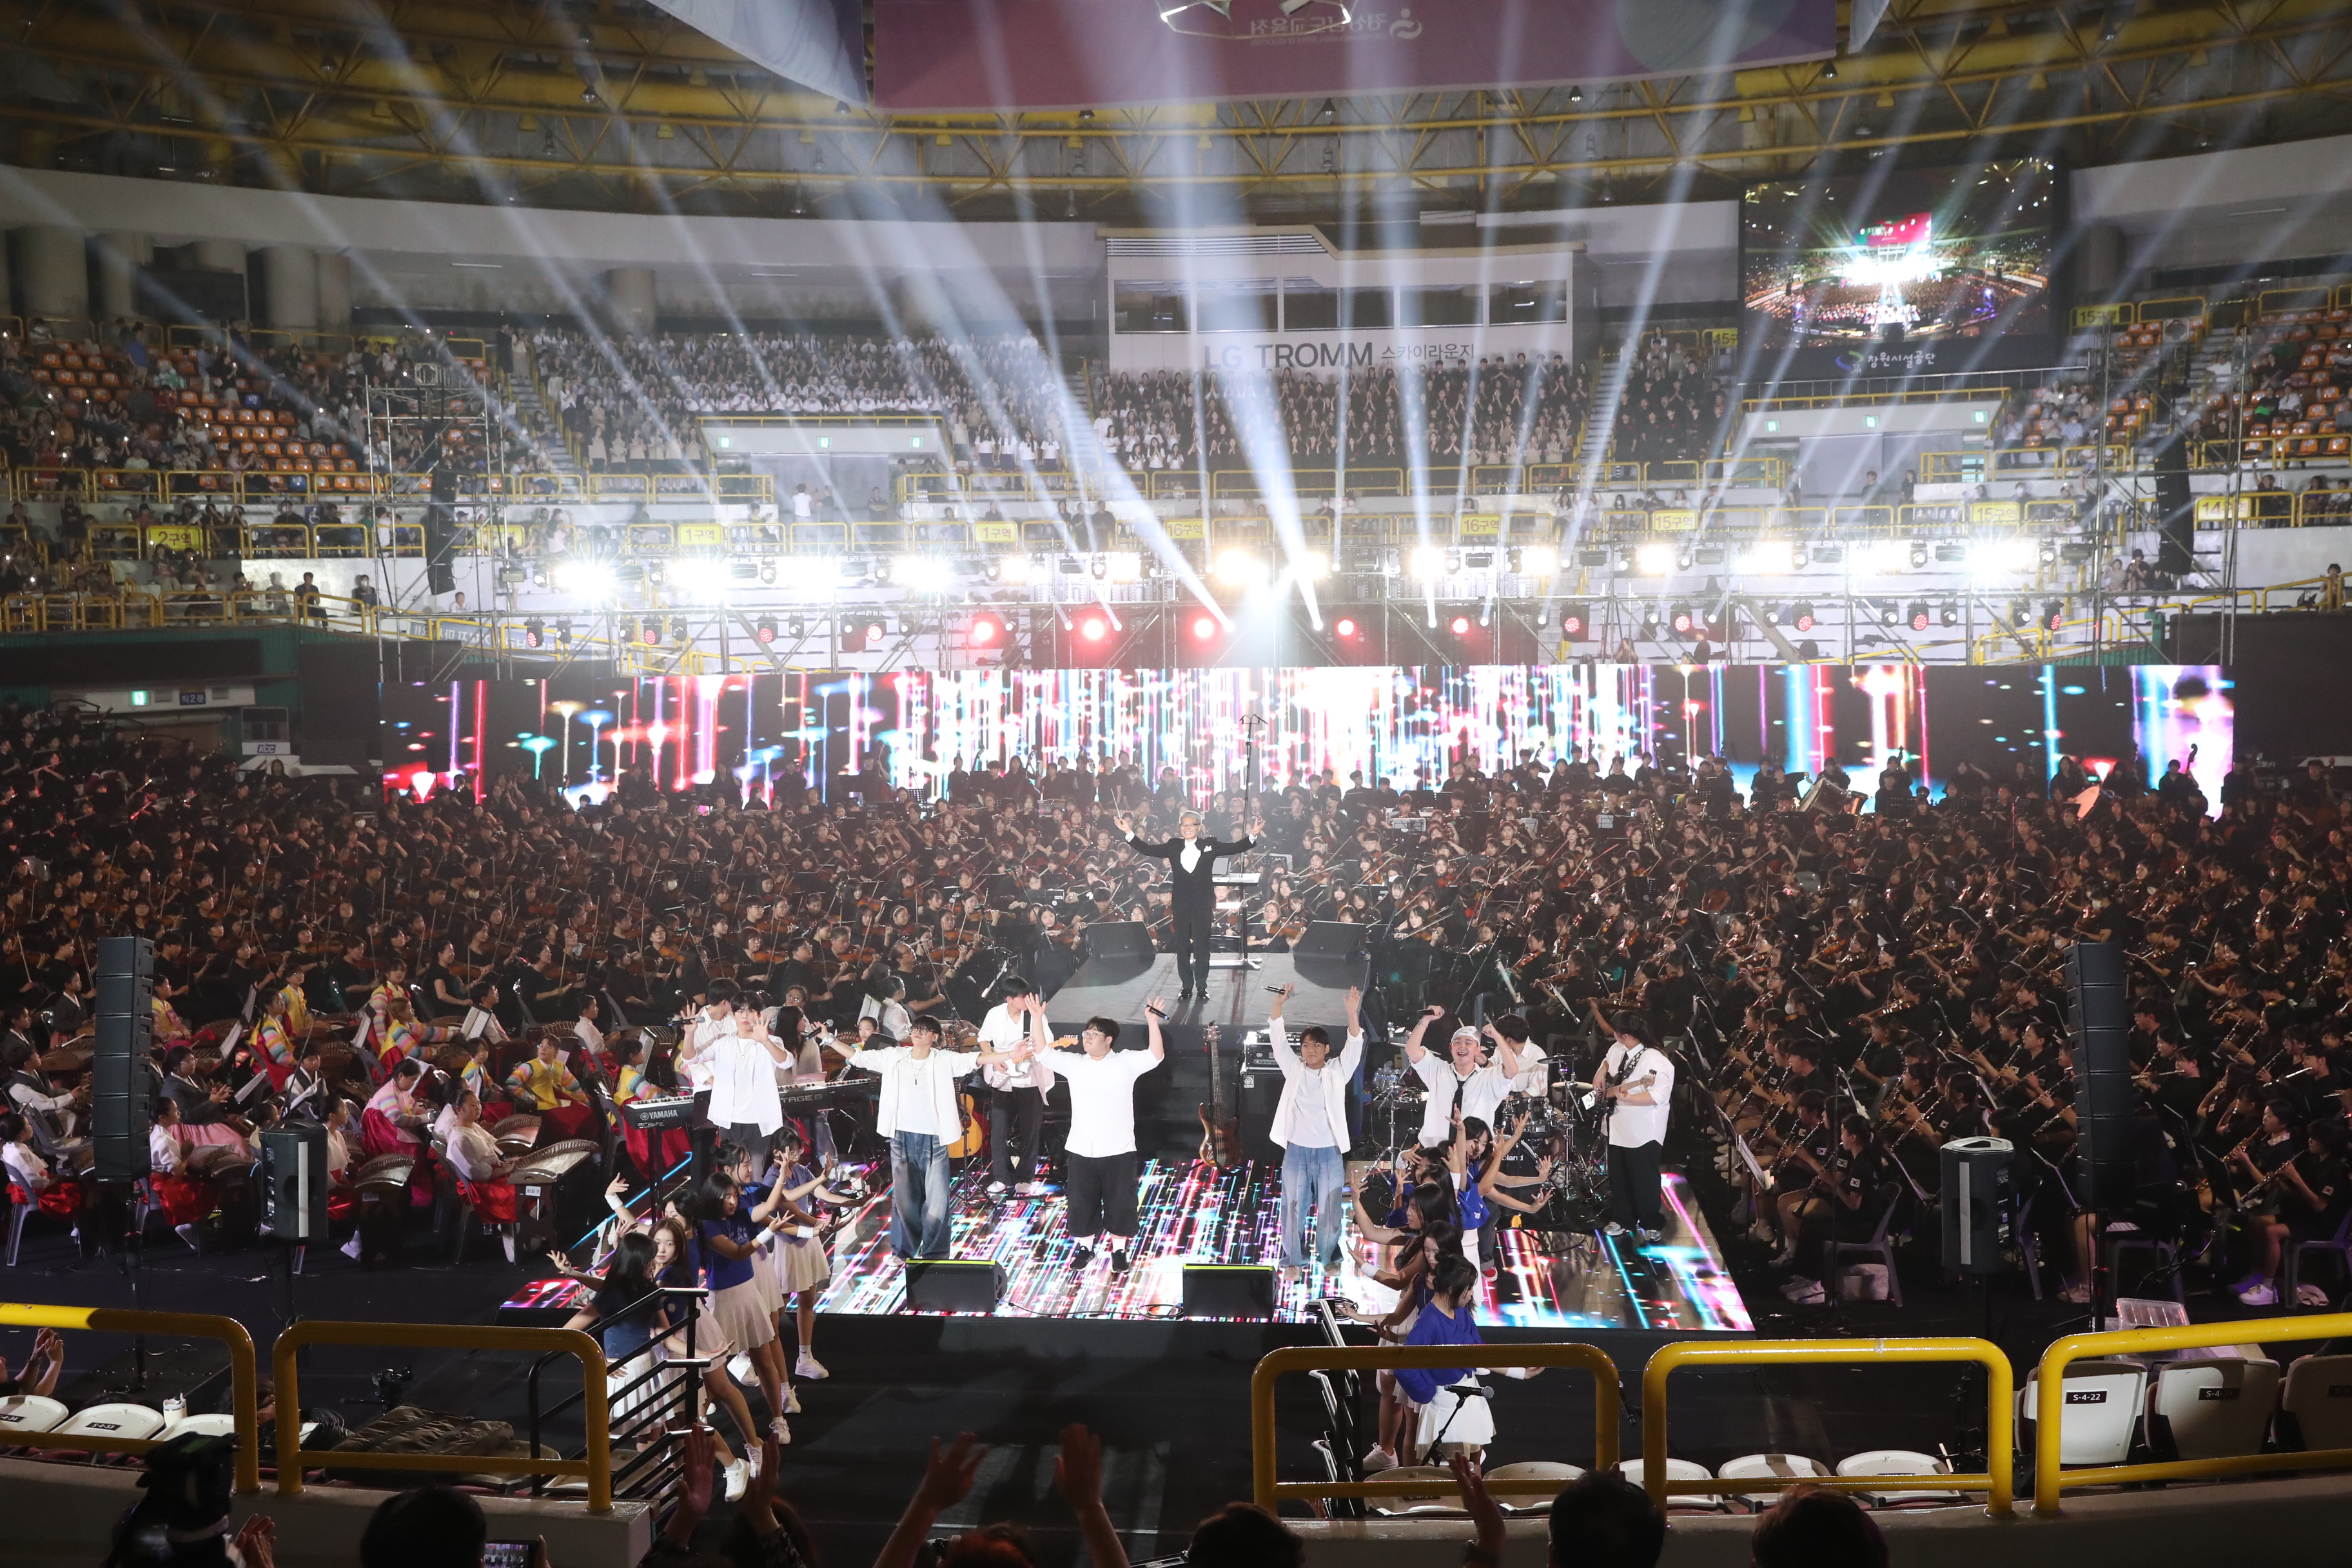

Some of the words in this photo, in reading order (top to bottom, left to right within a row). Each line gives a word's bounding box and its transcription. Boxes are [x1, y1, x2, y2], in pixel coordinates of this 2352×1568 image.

[1204, 345, 1242, 369] LG
[1255, 342, 1373, 368] TROMM
[1381, 343, 1475, 360] 스카이라운지
[1868, 350, 1936, 369] 창원시설공단
[1464, 519, 1500, 532] 16구역
[1656, 516, 1693, 529] 15구역
[686, 528, 714, 542] 1구역
[983, 527, 1011, 539] 1구역
[1168, 524, 1202, 536] 16구역
[158, 531, 192, 546] 2구역
[258, 744, 276, 754] KCC
[780, 1095, 813, 1104] TAGE
[649, 1110, 678, 1119] YAMAHA
[2073, 1393, 2101, 1402] S-4-22
